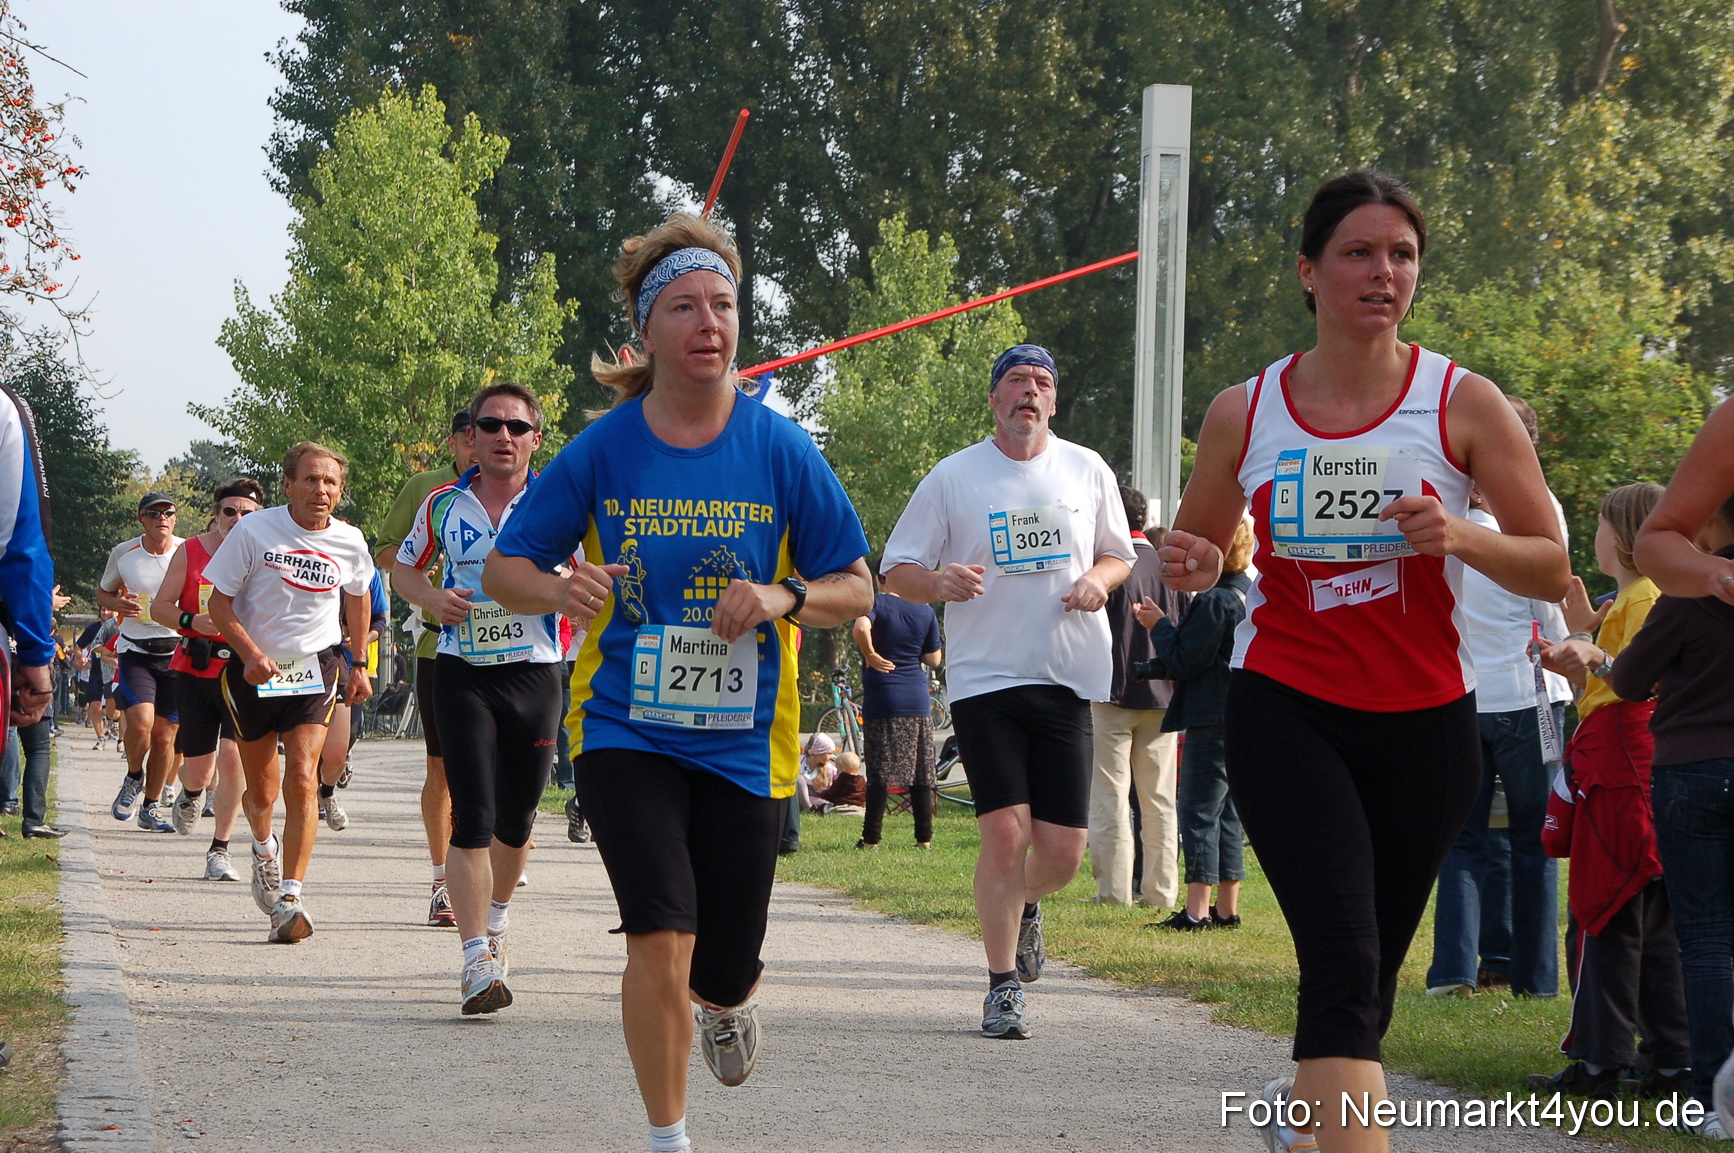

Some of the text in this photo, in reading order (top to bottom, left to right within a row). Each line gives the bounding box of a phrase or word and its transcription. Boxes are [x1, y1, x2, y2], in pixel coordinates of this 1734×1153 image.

[1312, 455, 1378, 476] Kerstin
[1280, 489, 1289, 504] C
[603, 499, 774, 524] 10. NEUMARKTER
[1011, 512, 1040, 527] Frank
[624, 518, 746, 539] STADTLAUF
[996, 534, 1002, 544] C
[1016, 528, 1062, 550] 3021
[1363, 542, 1412, 553] PFLEIDERE
[263, 551, 330, 573] GERHART
[456, 558, 486, 566] www.t
[473, 607, 515, 620] Christia
[682, 606, 715, 623] 20.0
[477, 622, 524, 643] 2643
[670, 634, 728, 656] Martina
[640, 660, 648, 675] C
[275, 669, 315, 684] 2424
[668, 665, 744, 693] 2713
